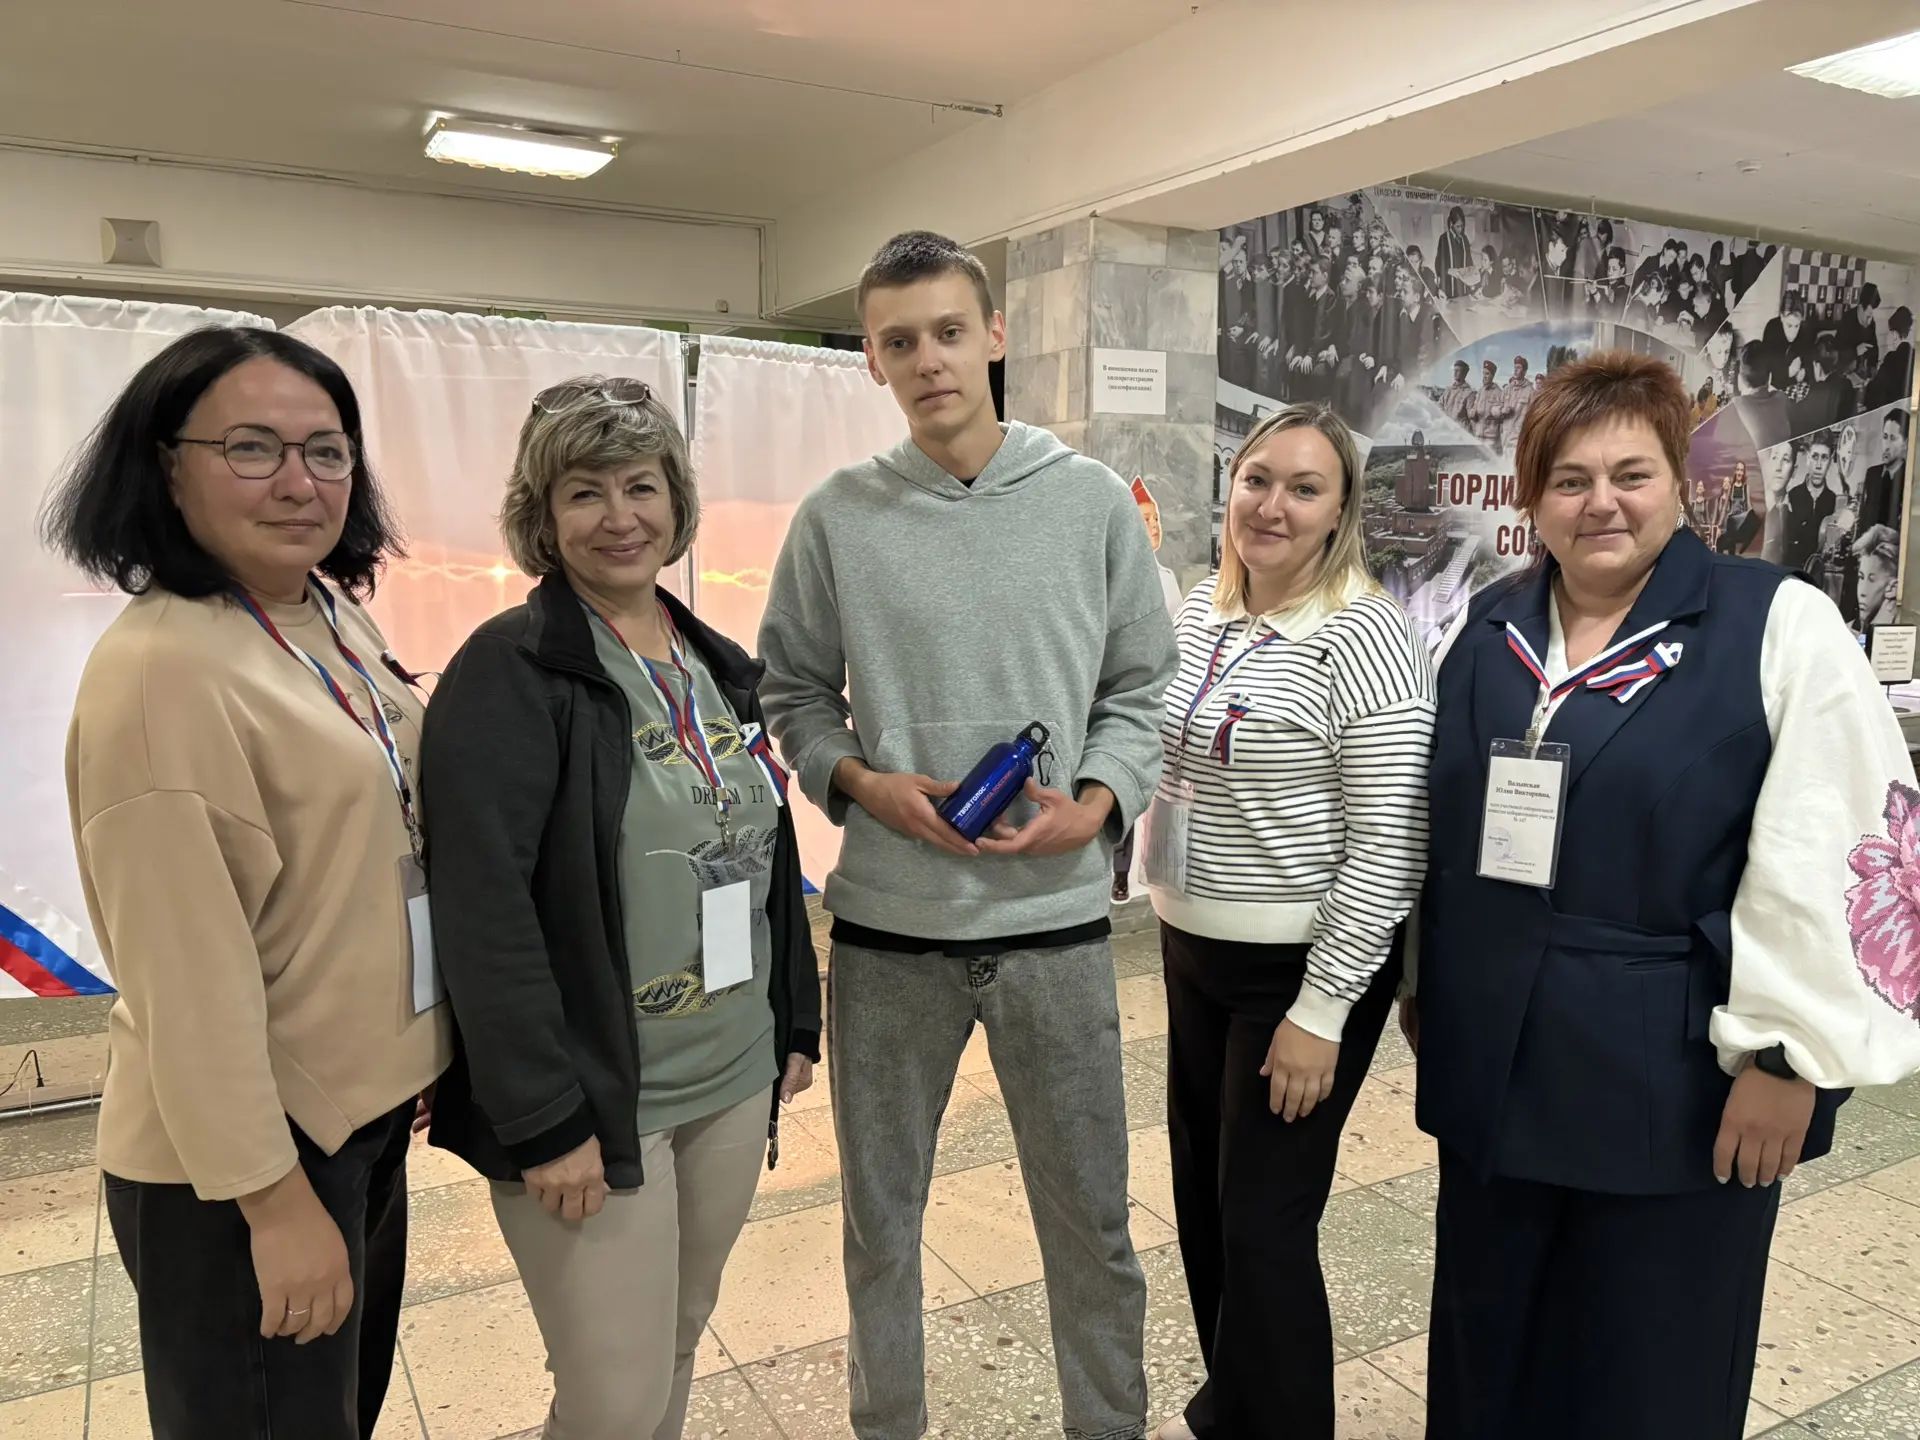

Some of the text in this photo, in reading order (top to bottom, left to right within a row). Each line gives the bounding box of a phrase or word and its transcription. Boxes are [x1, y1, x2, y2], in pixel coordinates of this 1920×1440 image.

[1436, 473, 1515, 511] ГОРДИ
[749, 785, 764, 803] IT
[958, 800, 972, 817] ТВОЙ
[970, 786, 986, 804] ГОЛОС
